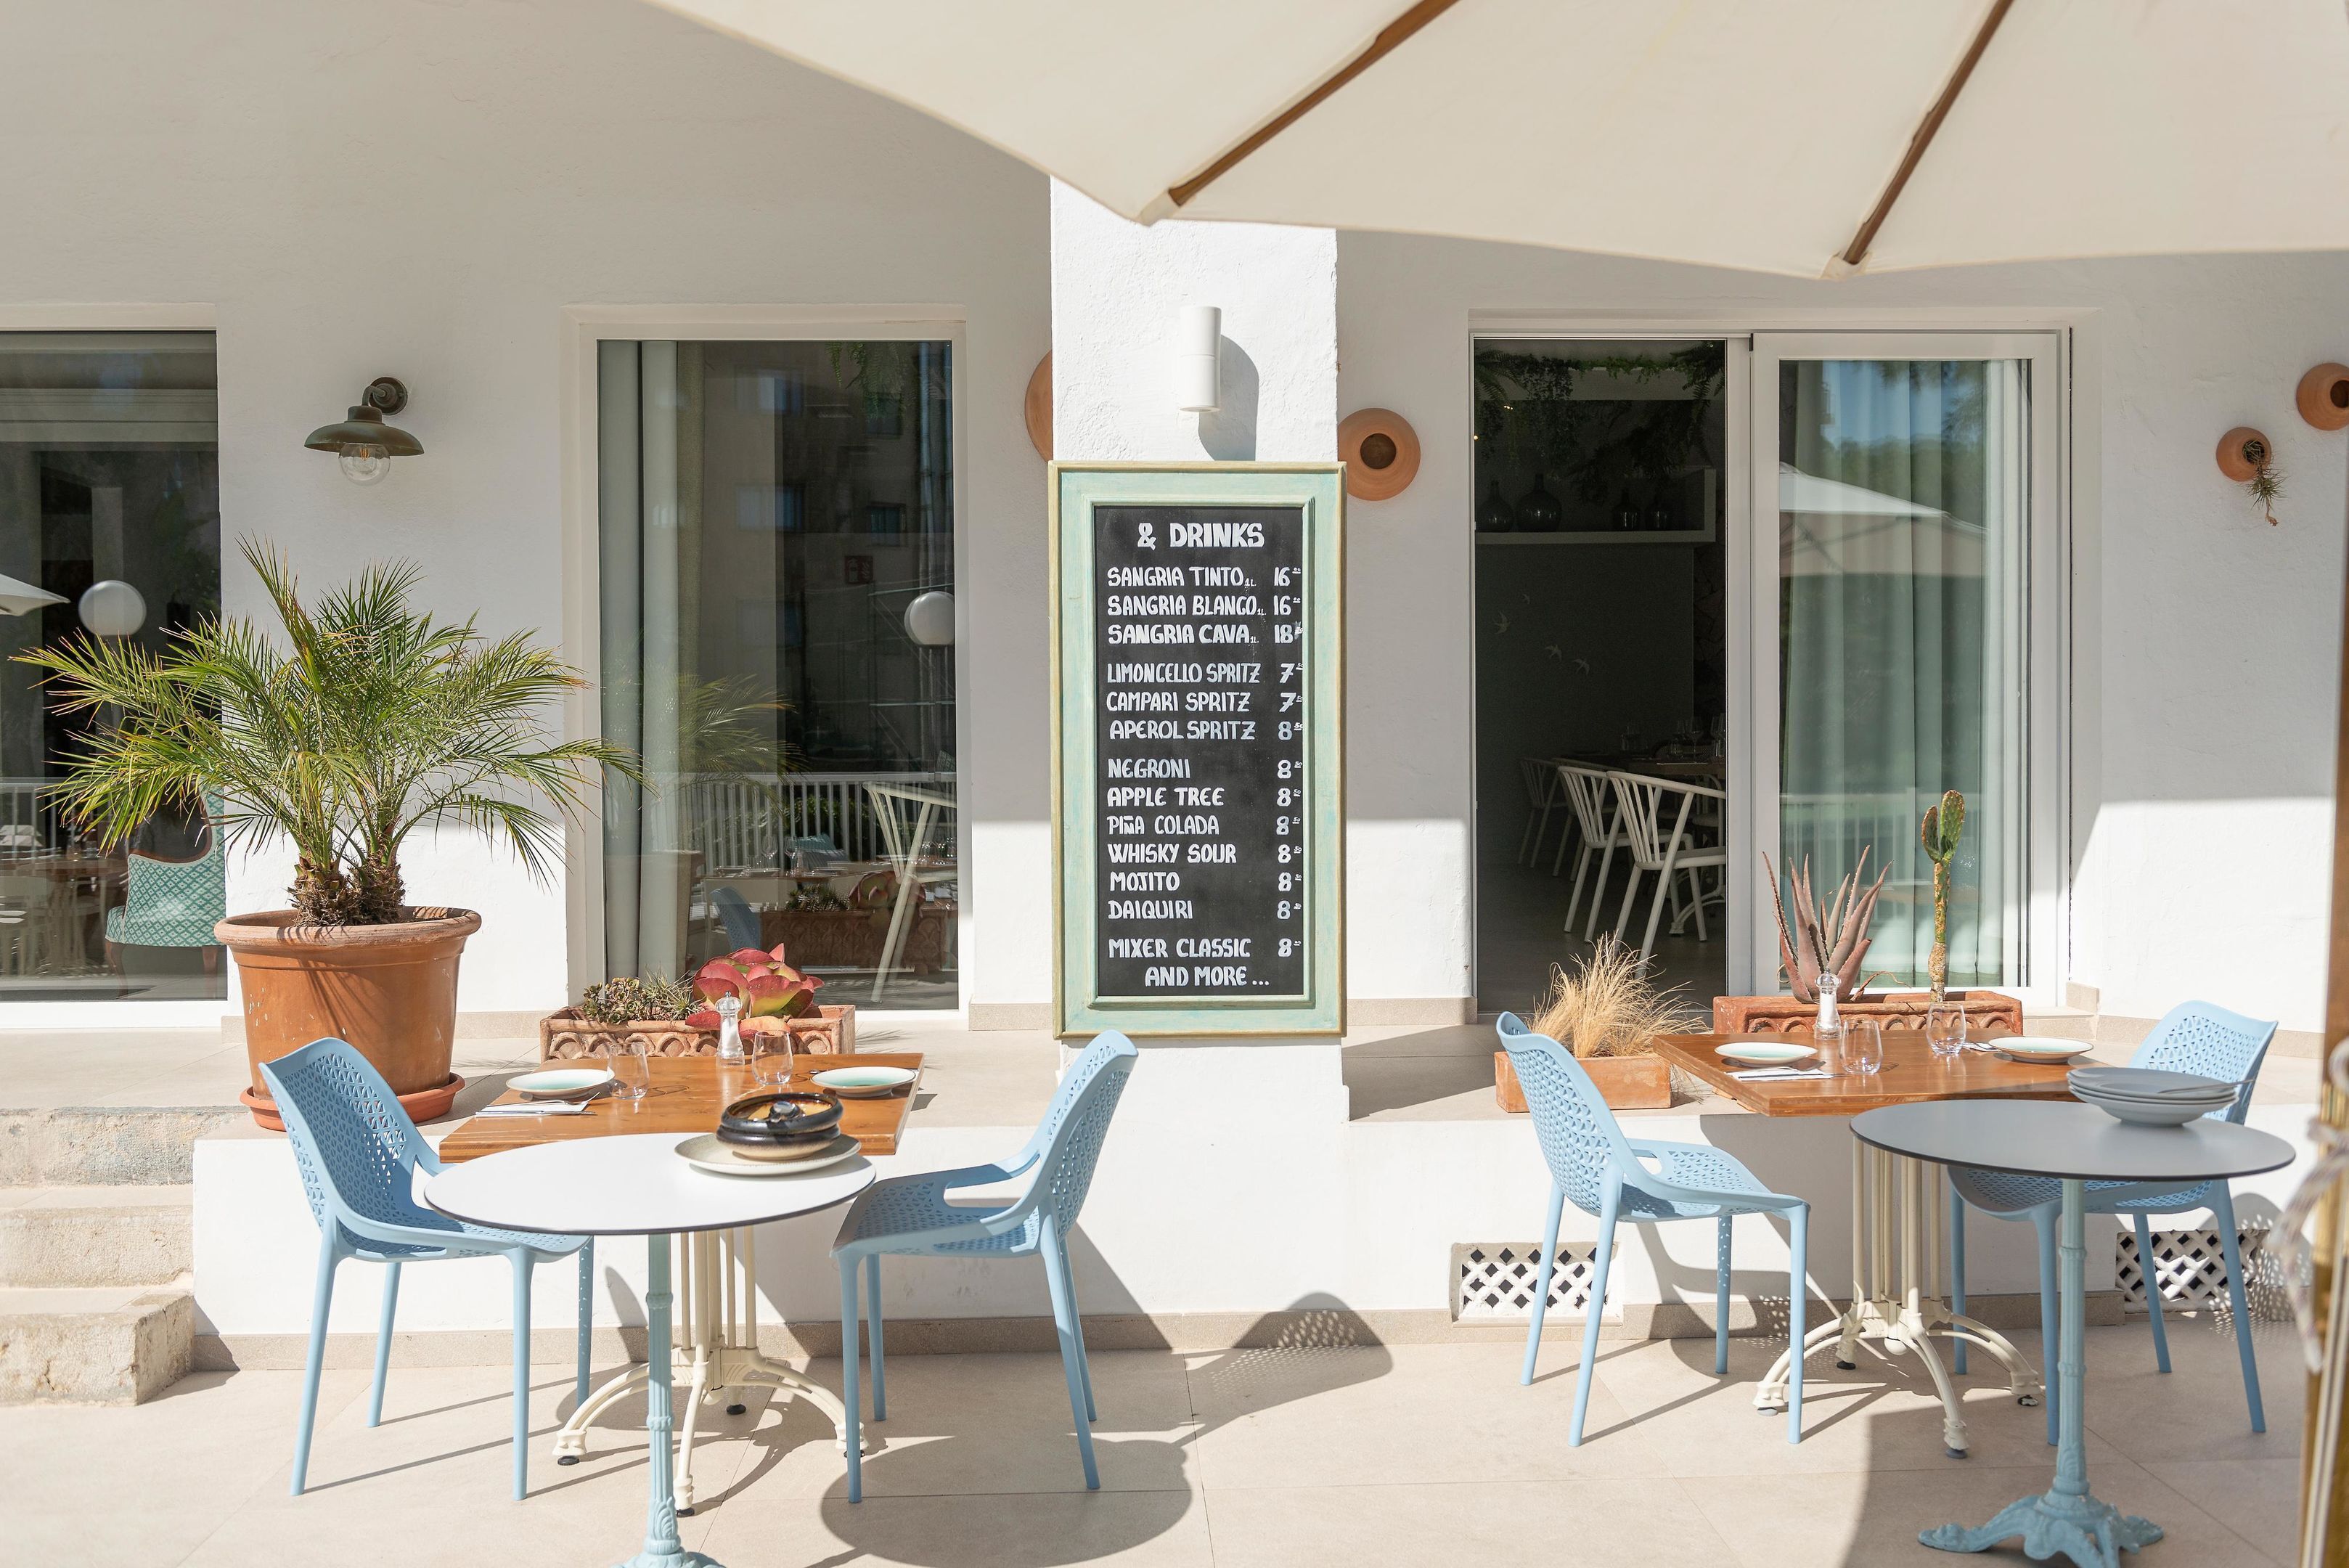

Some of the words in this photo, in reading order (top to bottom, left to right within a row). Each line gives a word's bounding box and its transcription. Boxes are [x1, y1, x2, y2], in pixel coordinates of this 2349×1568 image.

[1137, 523, 1156, 550] &
[1170, 523, 1265, 548] DRINKS
[1107, 567, 1185, 587] SANGRIA
[1189, 567, 1243, 587] TINTO
[1108, 595, 1186, 616] SANGRIA
[1108, 624, 1194, 644] SANGRIA
[1198, 624, 1249, 644] CAVA
[1108, 663, 1202, 683] LIMONCELLO
[1206, 663, 1261, 683] SPRITZ
[1106, 692, 1178, 711] CAMPARI
[1185, 692, 1251, 711] SPRITZ
[1110, 720, 1185, 740] APEROL
[1187, 720, 1255, 740] SPRITZ
[1108, 758, 1190, 778] NEGRONI
[1107, 787, 1167, 807] APPLE
[1174, 787, 1225, 806] TREE
[1107, 815, 1144, 835] PIÑA
[1155, 815, 1219, 835] COLADA
[1108, 844, 1180, 863] WHISKY
[1187, 844, 1236, 863] SOUR
[1110, 871, 1180, 891] MOJITO
[1108, 900, 1193, 920] DAIQUIRI
[1109, 939, 1168, 957] MIXER
[1176, 939, 1251, 957] CLASSIC
[1145, 966, 1188, 987] AND
